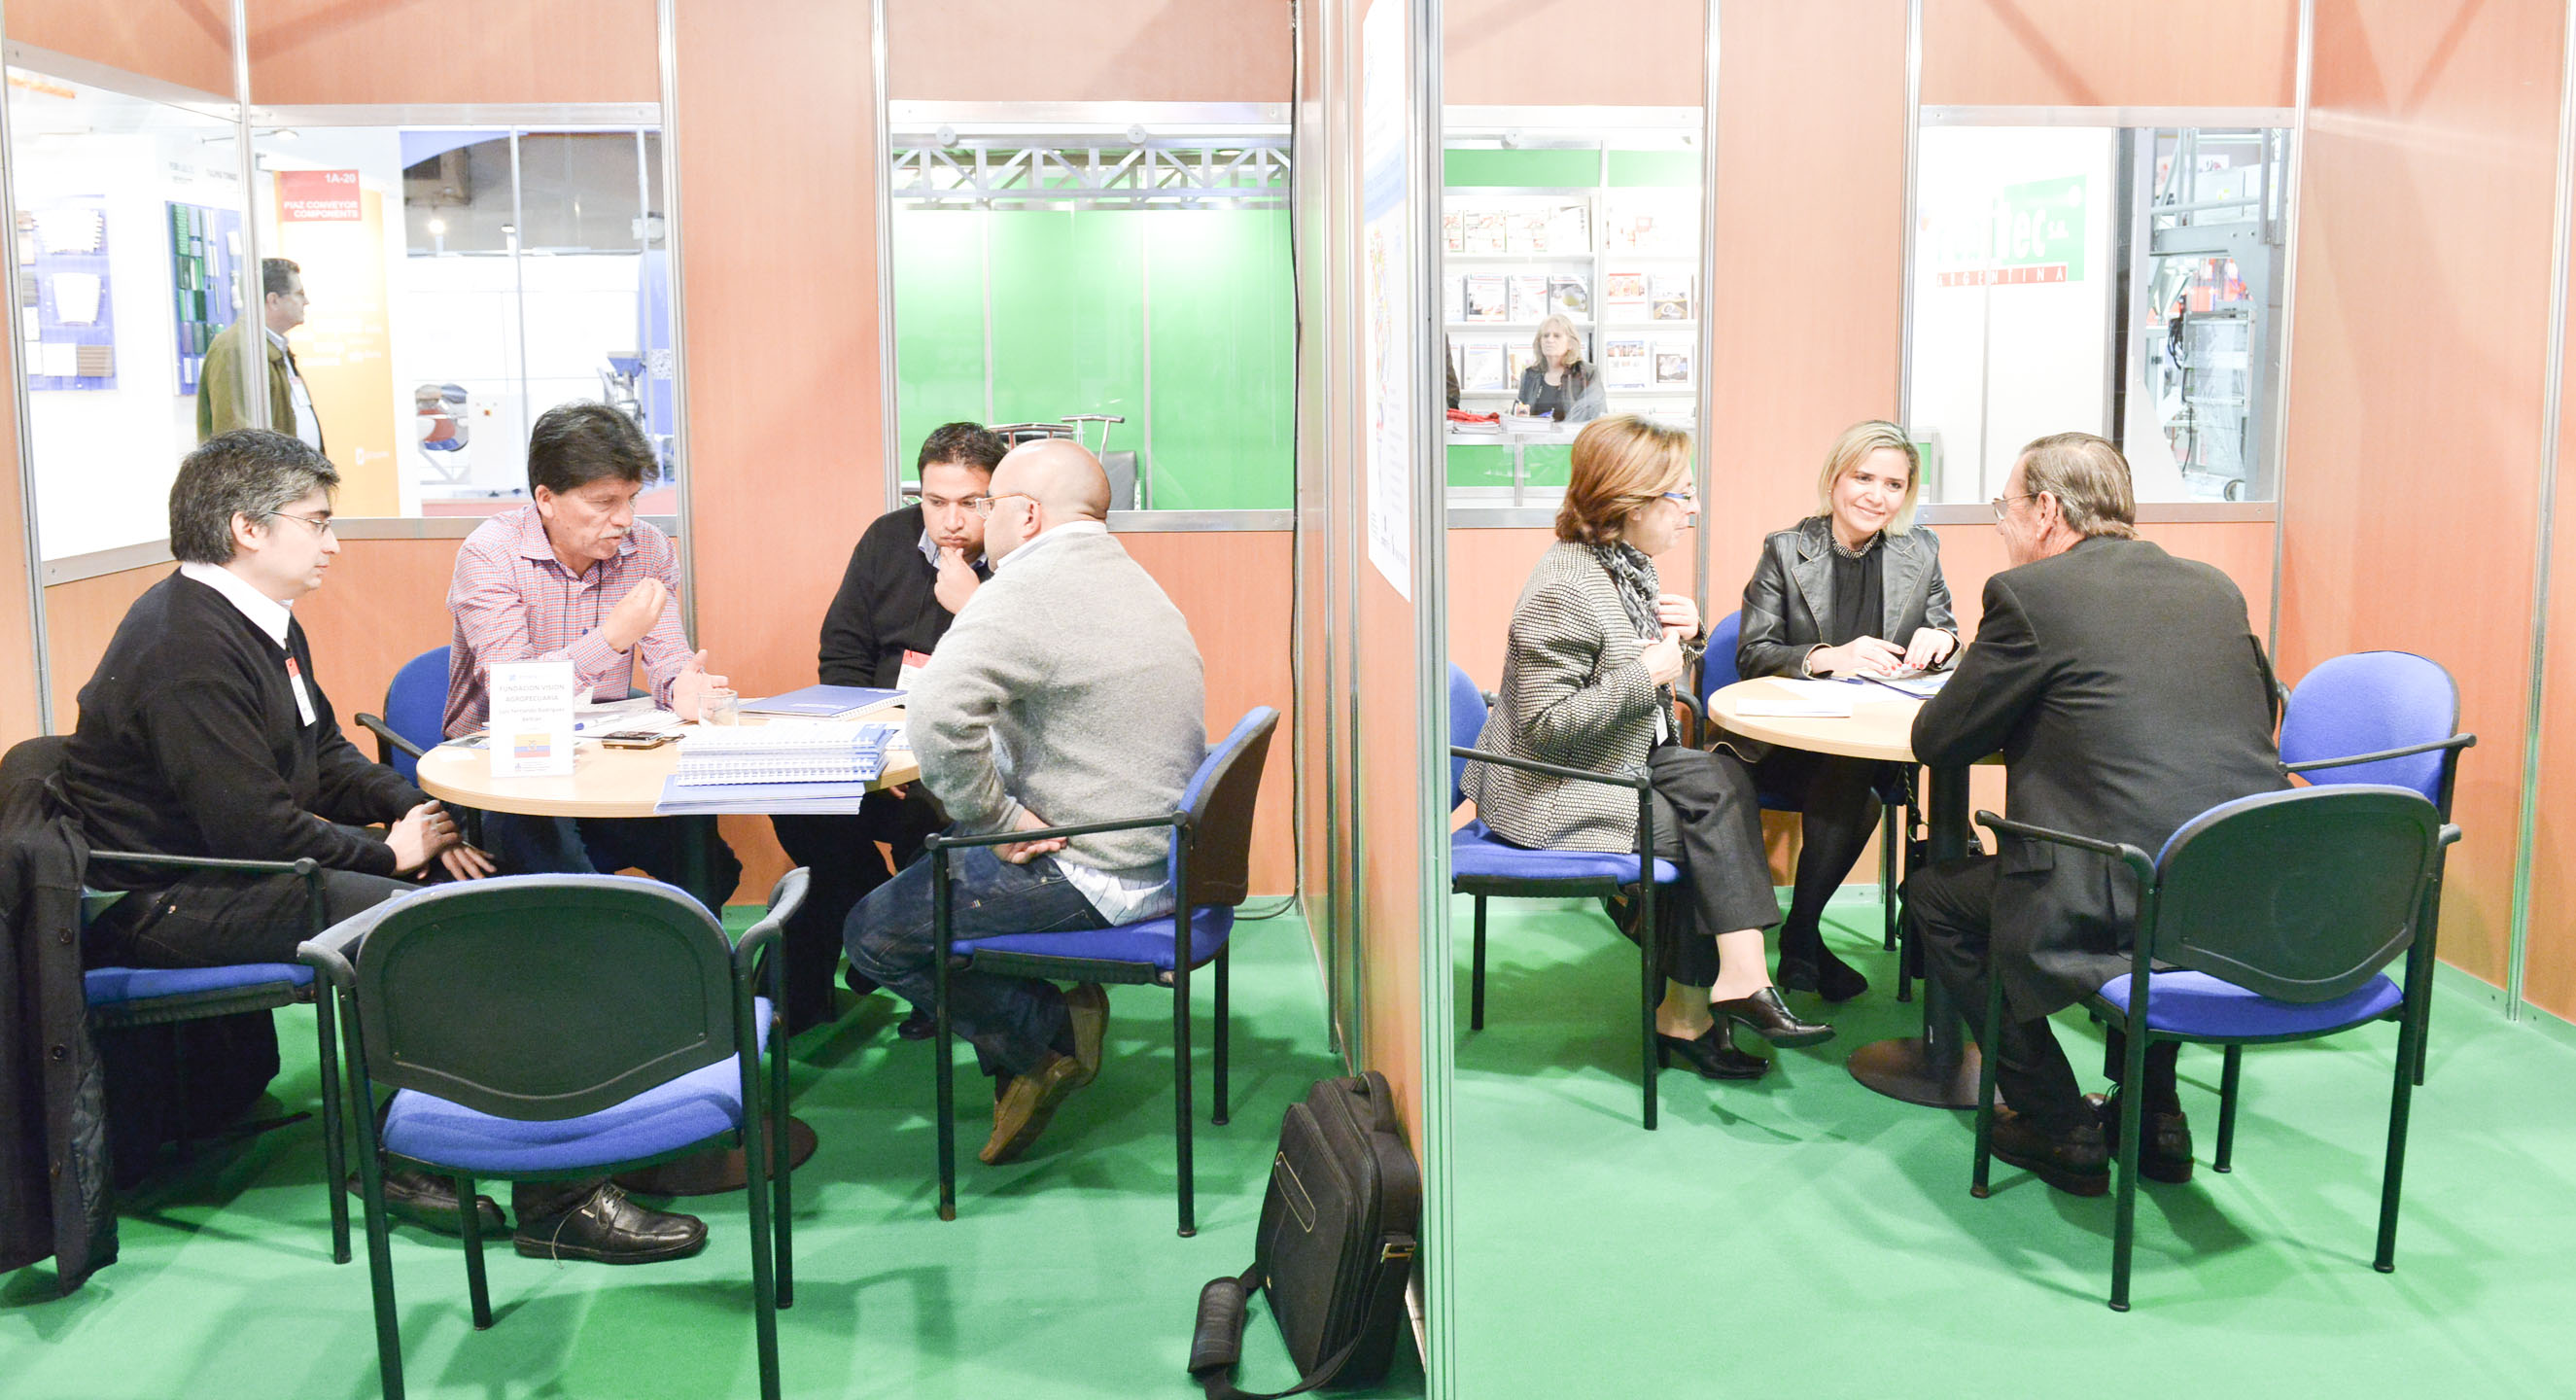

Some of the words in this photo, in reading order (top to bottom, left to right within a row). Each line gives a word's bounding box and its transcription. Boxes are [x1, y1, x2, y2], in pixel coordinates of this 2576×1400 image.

[325, 173, 357, 184] 1A-20
[305, 200, 359, 210] CONVEYOR
[293, 209, 359, 219] COMPONENTS
[1938, 267, 2064, 287] ARGENTINA
